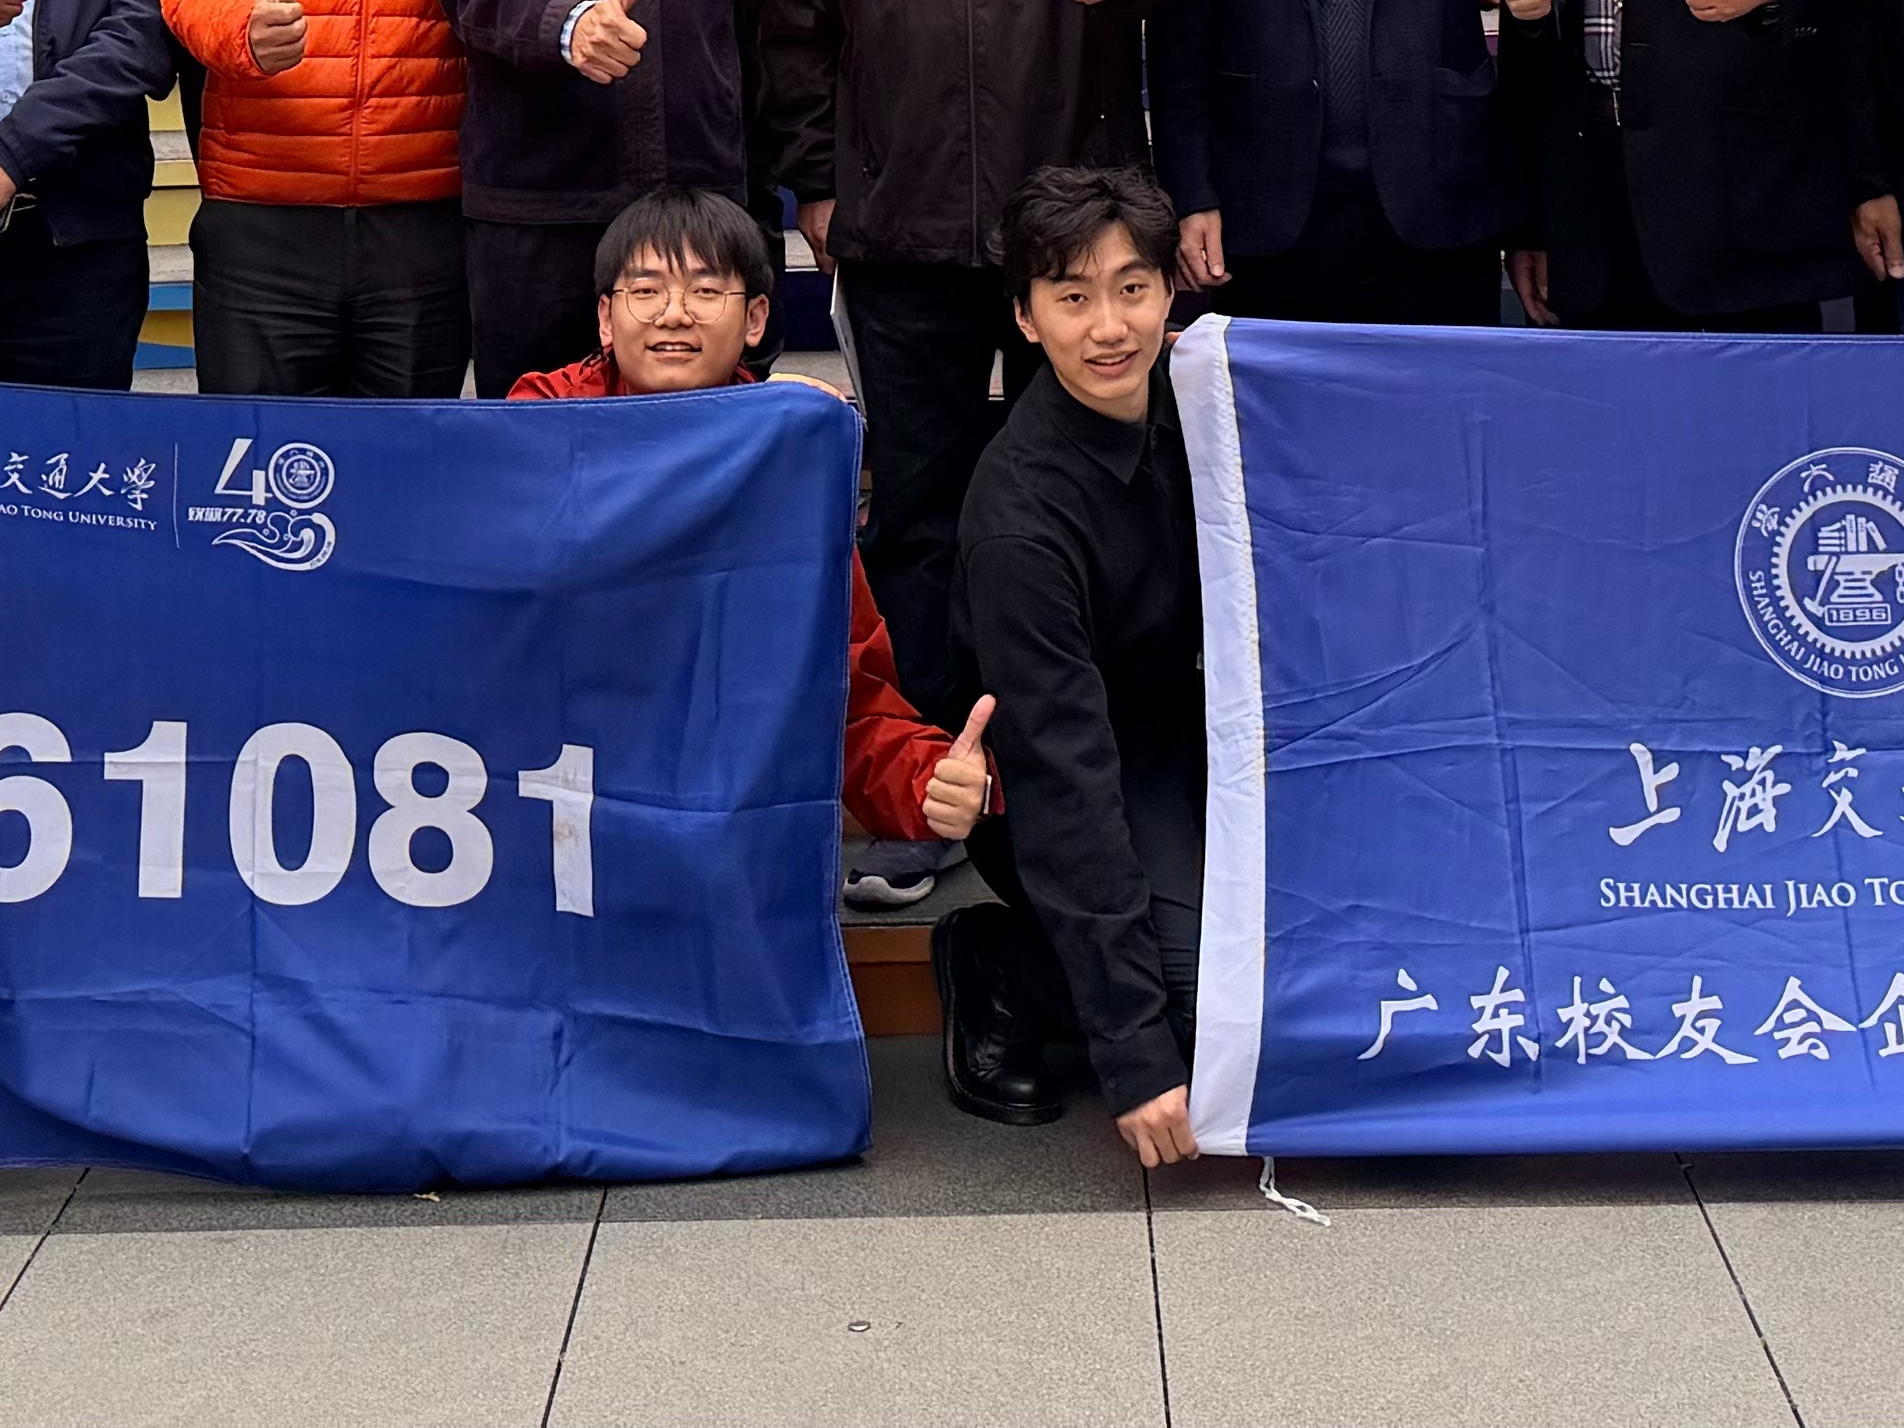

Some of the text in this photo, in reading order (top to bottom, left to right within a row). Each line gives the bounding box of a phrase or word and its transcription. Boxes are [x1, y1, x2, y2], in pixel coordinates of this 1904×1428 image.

[21, 505, 64, 521] TONG
[68, 510, 157, 531] UNIVERSITY
[1748, 569, 1805, 661] SHANGHAI
[1804, 653, 1844, 681] JIAO
[1848, 658, 1900, 683] TONG
[1828, 606, 1889, 622] 1896
[1599, 876, 1775, 912] SHANGHAI
[1783, 878, 1858, 918] JIAO
